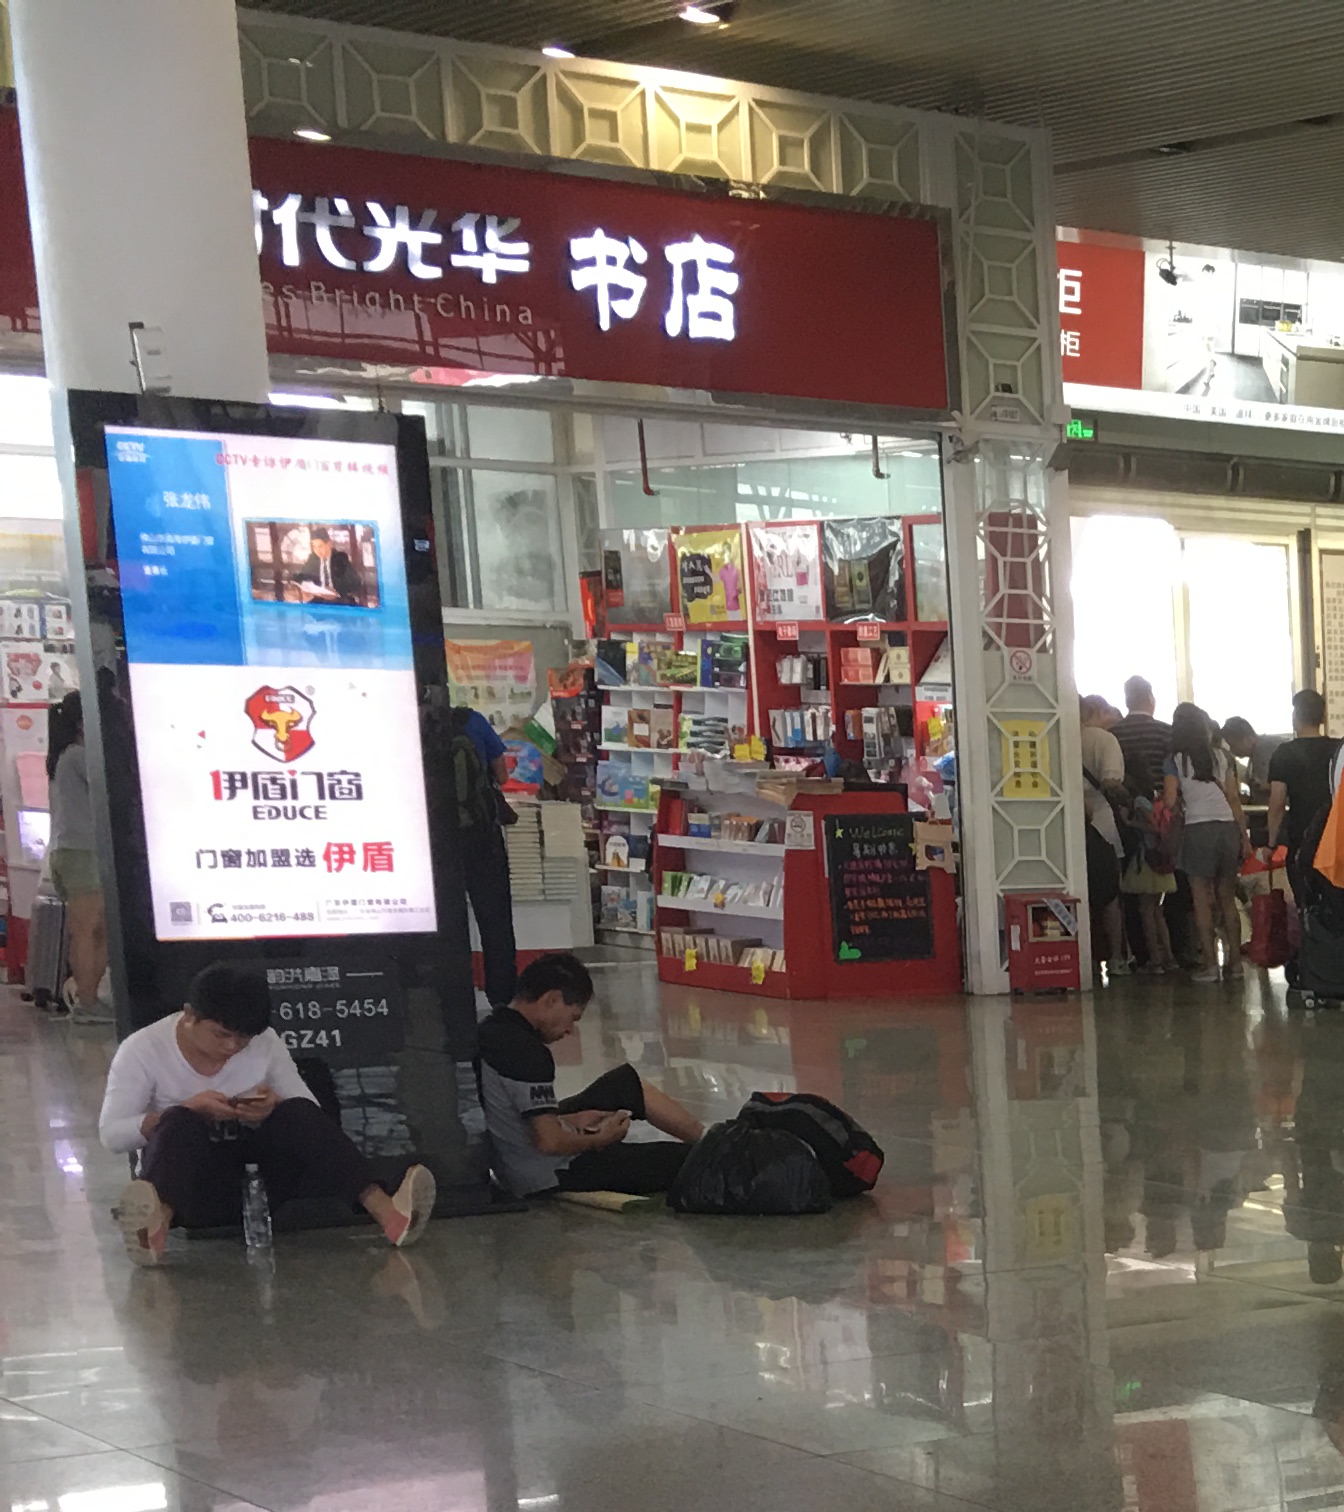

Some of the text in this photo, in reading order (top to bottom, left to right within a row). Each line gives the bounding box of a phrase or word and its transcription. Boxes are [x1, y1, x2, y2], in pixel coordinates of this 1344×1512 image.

[569, 227, 740, 342] 书店
[310, 281, 428, 315] Bright
[436, 292, 533, 325] China
[209, 769, 364, 803] 伊盾门窗
[252, 805, 328, 821] EDUCE
[195, 841, 395, 873] 门窗加盟选 伊盾
